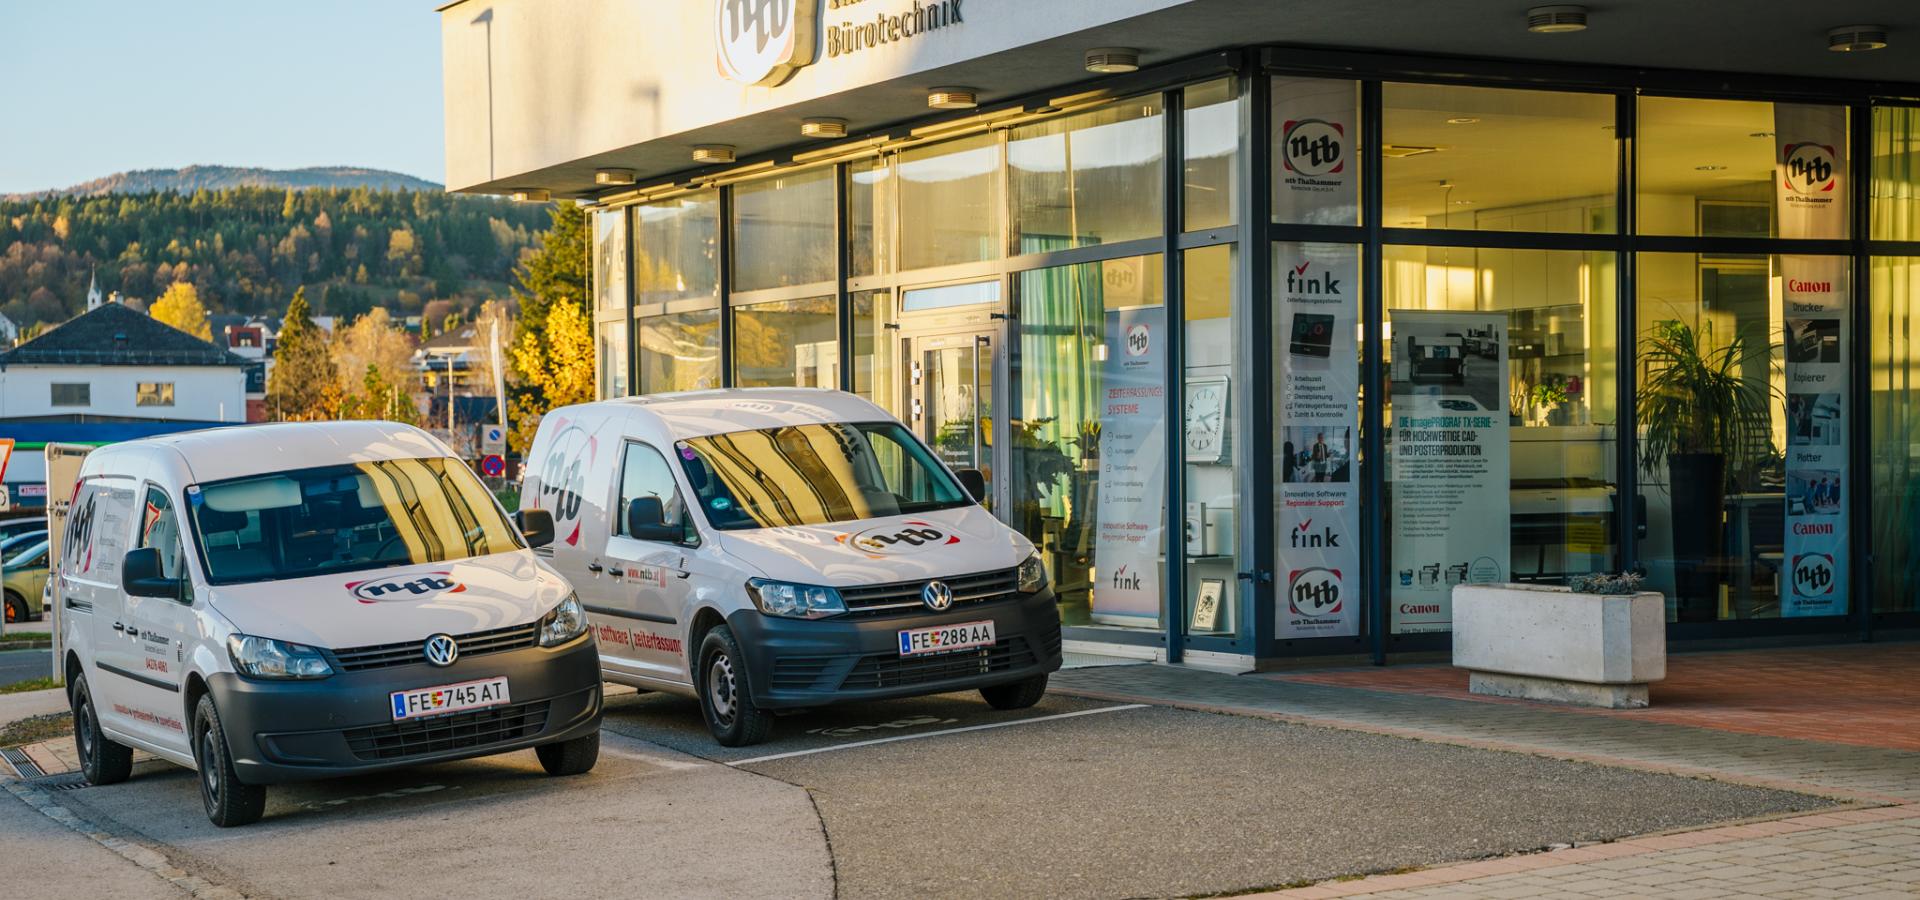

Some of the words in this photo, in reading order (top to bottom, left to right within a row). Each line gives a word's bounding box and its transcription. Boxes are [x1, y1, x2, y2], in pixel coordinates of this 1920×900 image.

[827, 0, 964, 58] Bürotechnik
[1290, 135, 1340, 167] ntb
[1790, 156, 1832, 186] ntb
[1288, 270, 1341, 295] fink
[1789, 279, 1831, 293] Canon
[1793, 302, 1825, 313] Drucker
[1129, 333, 1148, 351] ntb
[1108, 404, 1139, 416] SYSTEME
[1399, 416, 1410, 428] DIE
[1463, 416, 1492, 428] TX-SERIE
[1400, 430, 1412, 442] FÜR
[1412, 430, 1461, 442] HOCHWERTIGE
[1462, 430, 1478, 442] CAD-
[1400, 444, 1412, 456] UND
[1414, 444, 1482, 456] POSTERPRODUKTION
[1796, 452, 1822, 463] Plotter
[1316, 490, 1347, 498] Software
[1290, 526, 1340, 548] fink
[1792, 522, 1834, 535] Canon
[1114, 571, 1141, 590] fink
[1797, 563, 1832, 590] ntb
[364, 577, 456, 597] ntb
[1296, 580, 1340, 608] ntb
[1400, 604, 1440, 614] Canon
[600, 625, 628, 645] software
[912, 632, 930, 650] FE
[940, 629, 968, 646] 288
[971, 626, 990, 642] AA
[409, 693, 432, 712] FE
[444, 686, 477, 708] 745
[481, 682, 502, 701] AT
